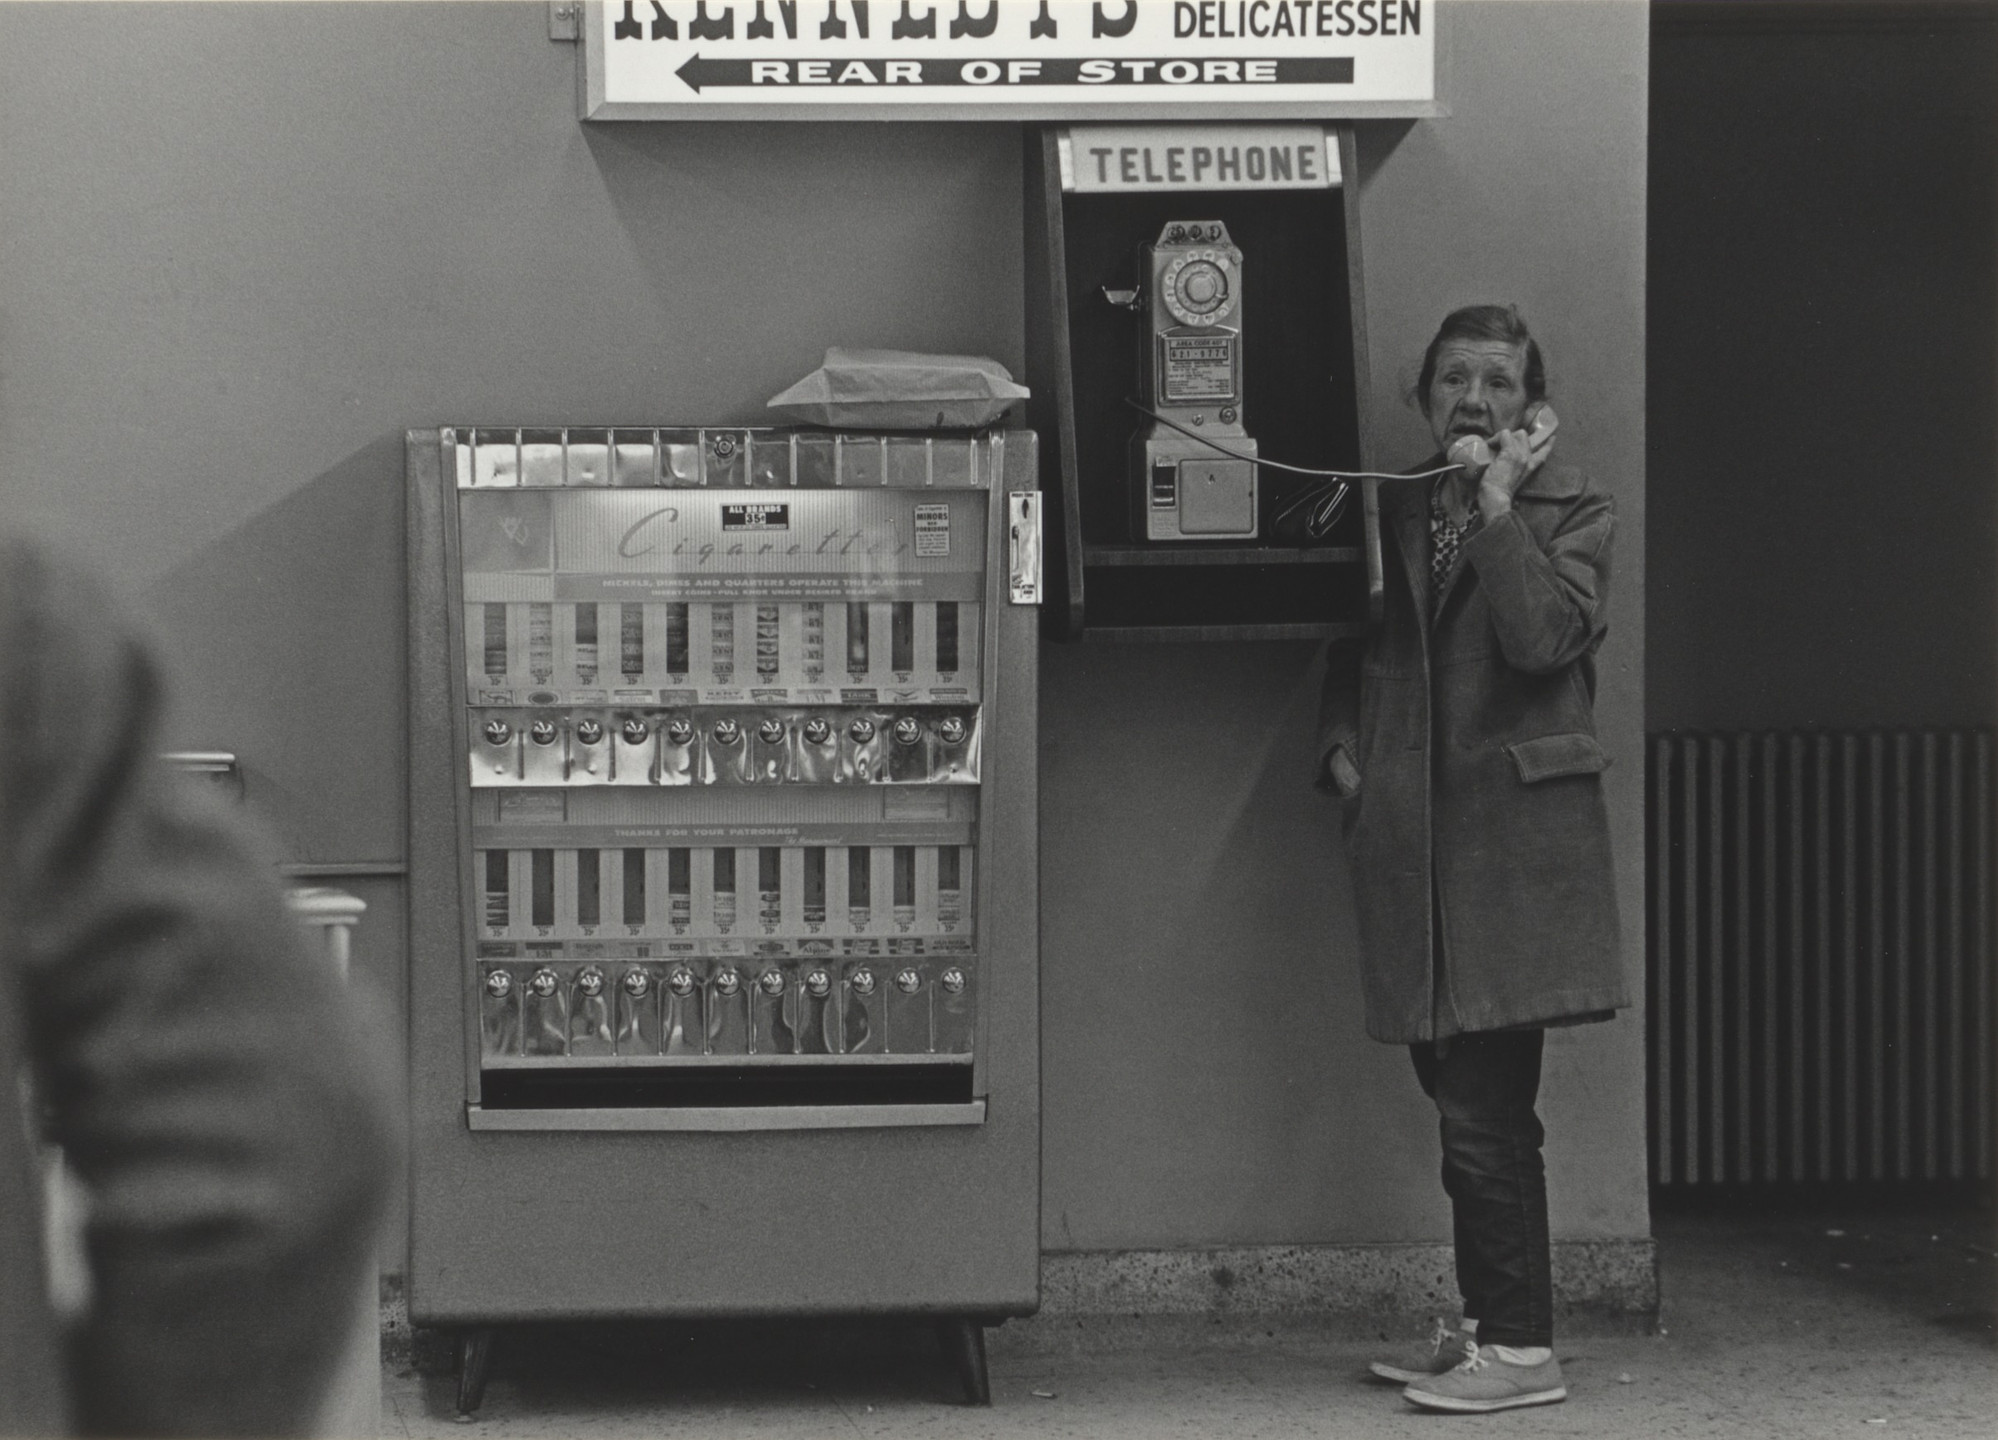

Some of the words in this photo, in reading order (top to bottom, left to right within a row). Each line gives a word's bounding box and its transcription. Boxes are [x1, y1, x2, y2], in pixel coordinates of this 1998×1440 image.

[1174, 0, 1421, 38] DELICATESSEN
[752, 61, 923, 83] REAR
[960, 60, 1042, 84] OF
[1077, 60, 1278, 84] STORE
[1089, 145, 1318, 183] TELEPHONE
[729, 505, 744, 513] ALL
[746, 505, 782, 513] BRANDS
[603, 580, 652, 588] NICKELS,
[789, 579, 839, 587] OPERATE
[843, 579, 868, 587] THIS
[872, 579, 923, 587] MACHINE
[730, 828, 799, 836] PATRONAGE
